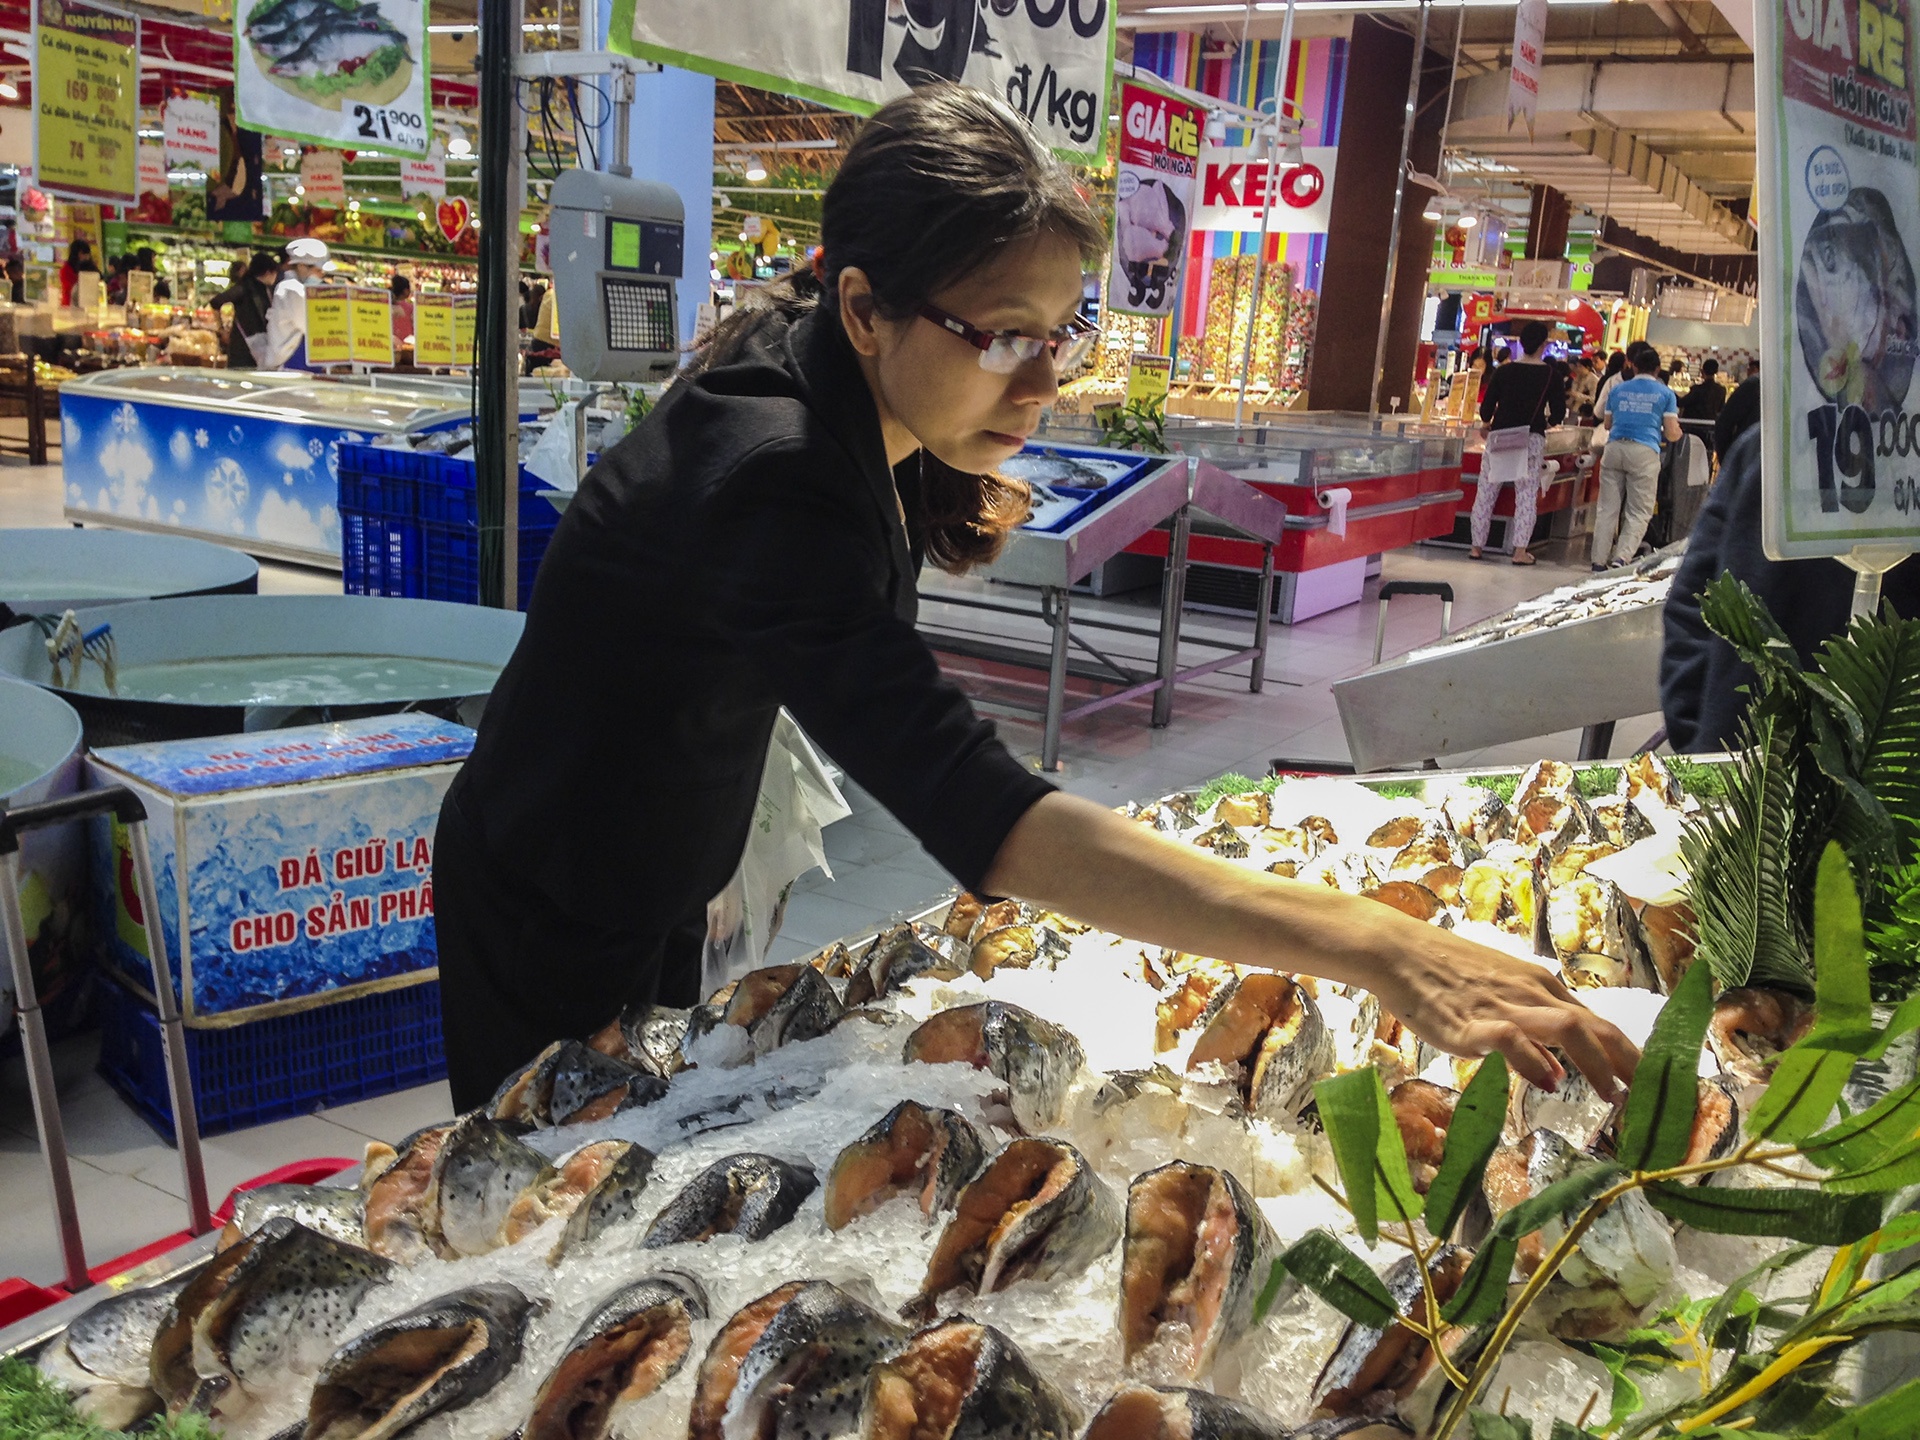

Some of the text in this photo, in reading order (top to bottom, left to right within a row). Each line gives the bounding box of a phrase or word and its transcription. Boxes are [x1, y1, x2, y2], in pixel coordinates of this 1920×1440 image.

[67, 80, 88, 102] 169
[1006, 63, 1097, 143] đ/kg
[1865, 84, 1909, 131] NGÀY
[354, 105, 422, 141] 21 900
[1127, 101, 1199, 157] GIÁ RẺ
[1171, 156, 1194, 175] NGÀ
[1203, 162, 1325, 219] KẸO
[1807, 405, 1876, 514] 19
[181, 762, 251, 777] CHO
[280, 838, 431, 890] ĐÁ GIỮ LẠ
[232, 874, 435, 952] CHO SẢN PHẨ
